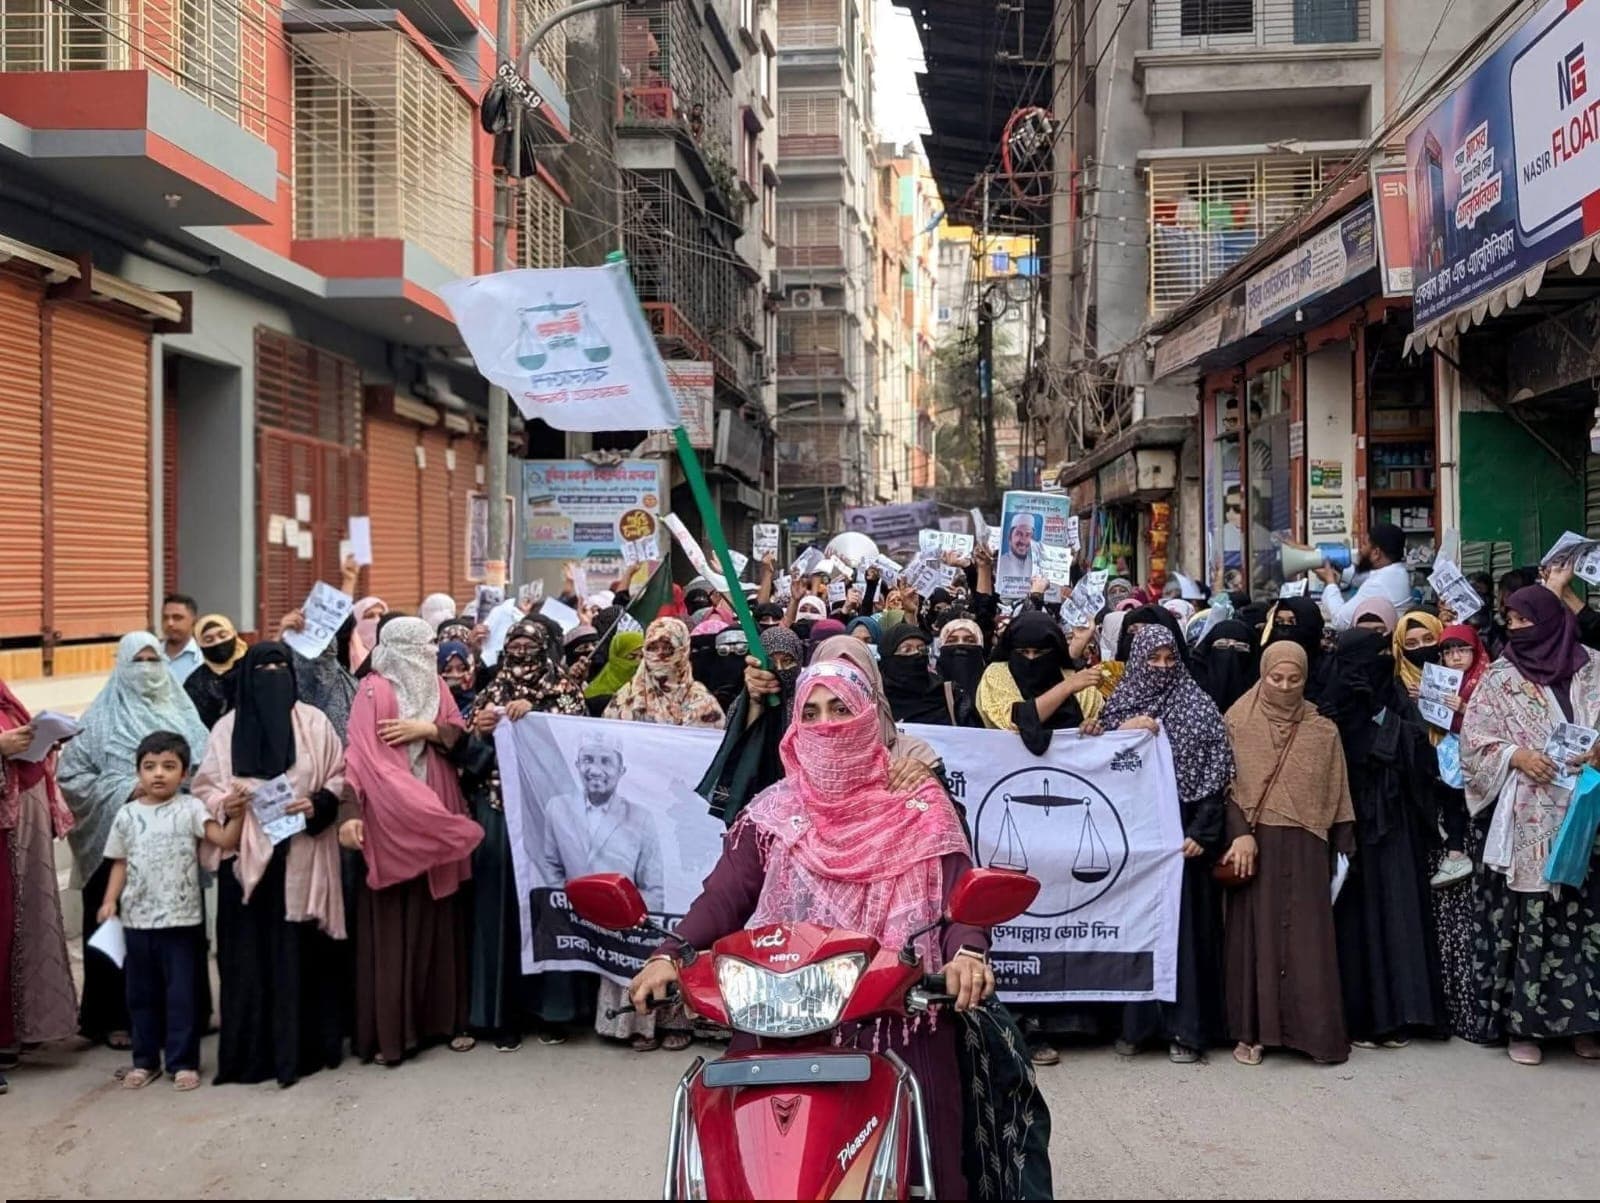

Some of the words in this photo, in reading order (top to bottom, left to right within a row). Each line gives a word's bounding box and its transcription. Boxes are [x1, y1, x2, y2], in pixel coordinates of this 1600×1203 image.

[498, 64, 541, 107] 6205-19
[1523, 150, 1551, 184] NASIR
[1552, 99, 1600, 168] FLOAT
[1055, 921, 1088, 939] ভোট
[1091, 920, 1120, 939] দিন
[992, 955, 1041, 975] সলামী
[836, 1115, 878, 1170] Pleasure
